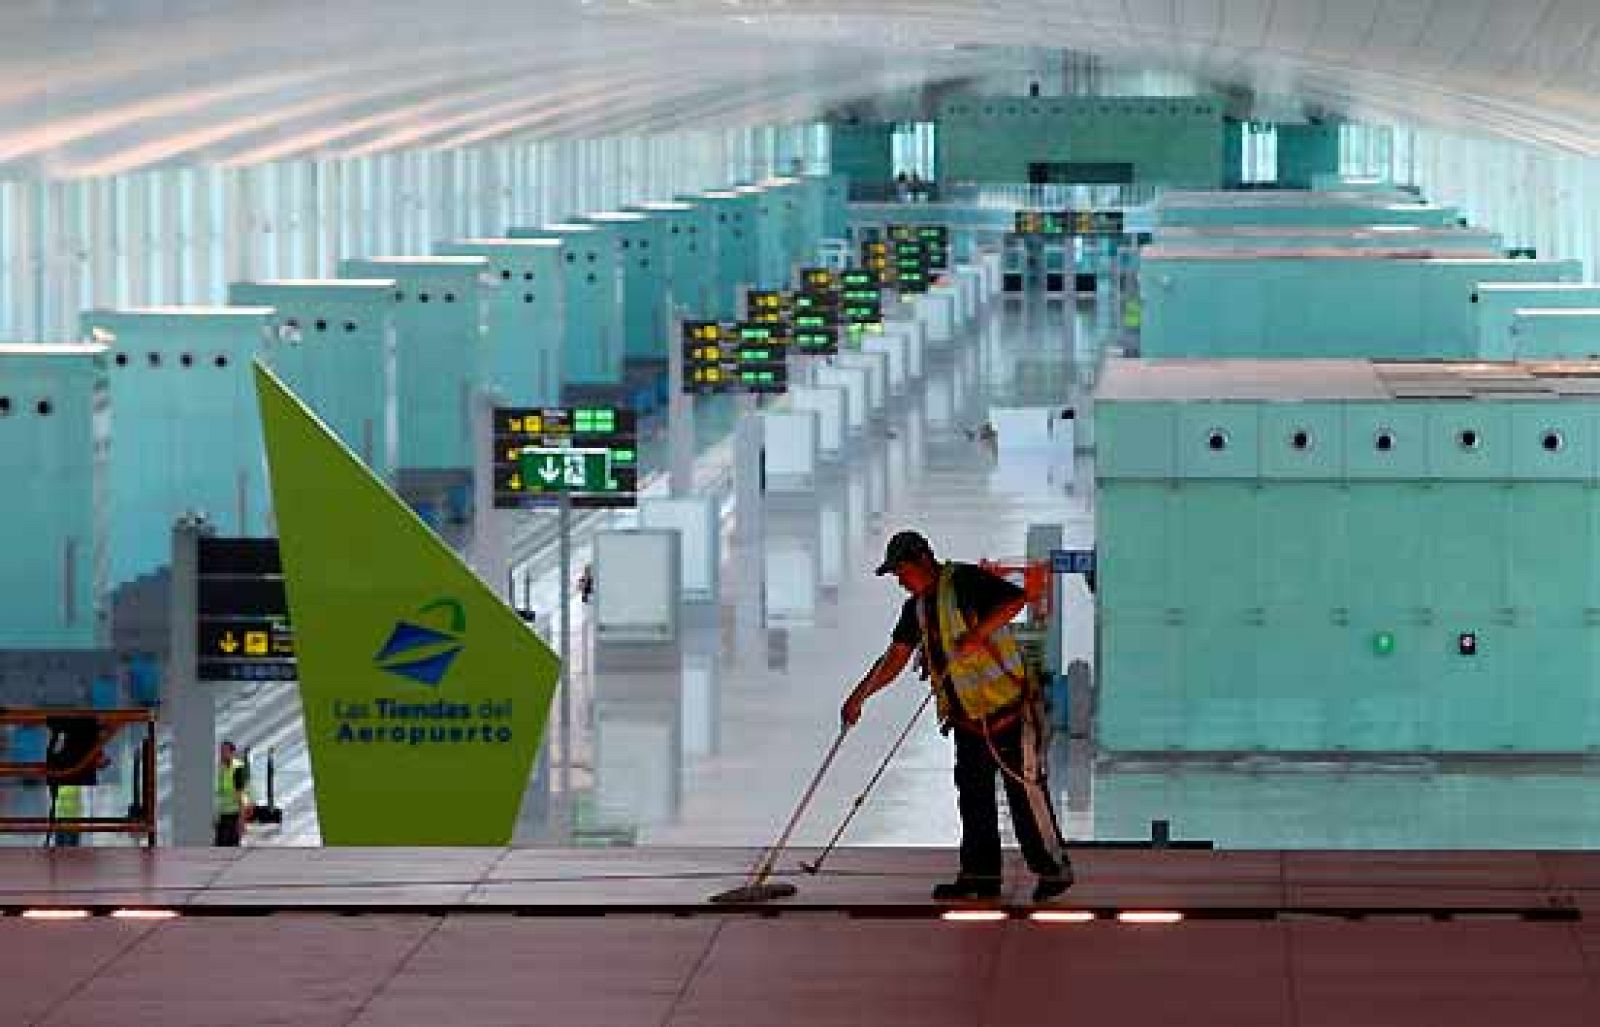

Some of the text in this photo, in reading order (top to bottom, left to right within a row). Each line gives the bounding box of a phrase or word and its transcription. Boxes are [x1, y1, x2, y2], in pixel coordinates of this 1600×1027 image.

[334, 697, 513, 718] Las Tiendas del
[337, 723, 513, 745] Aeropuerto
